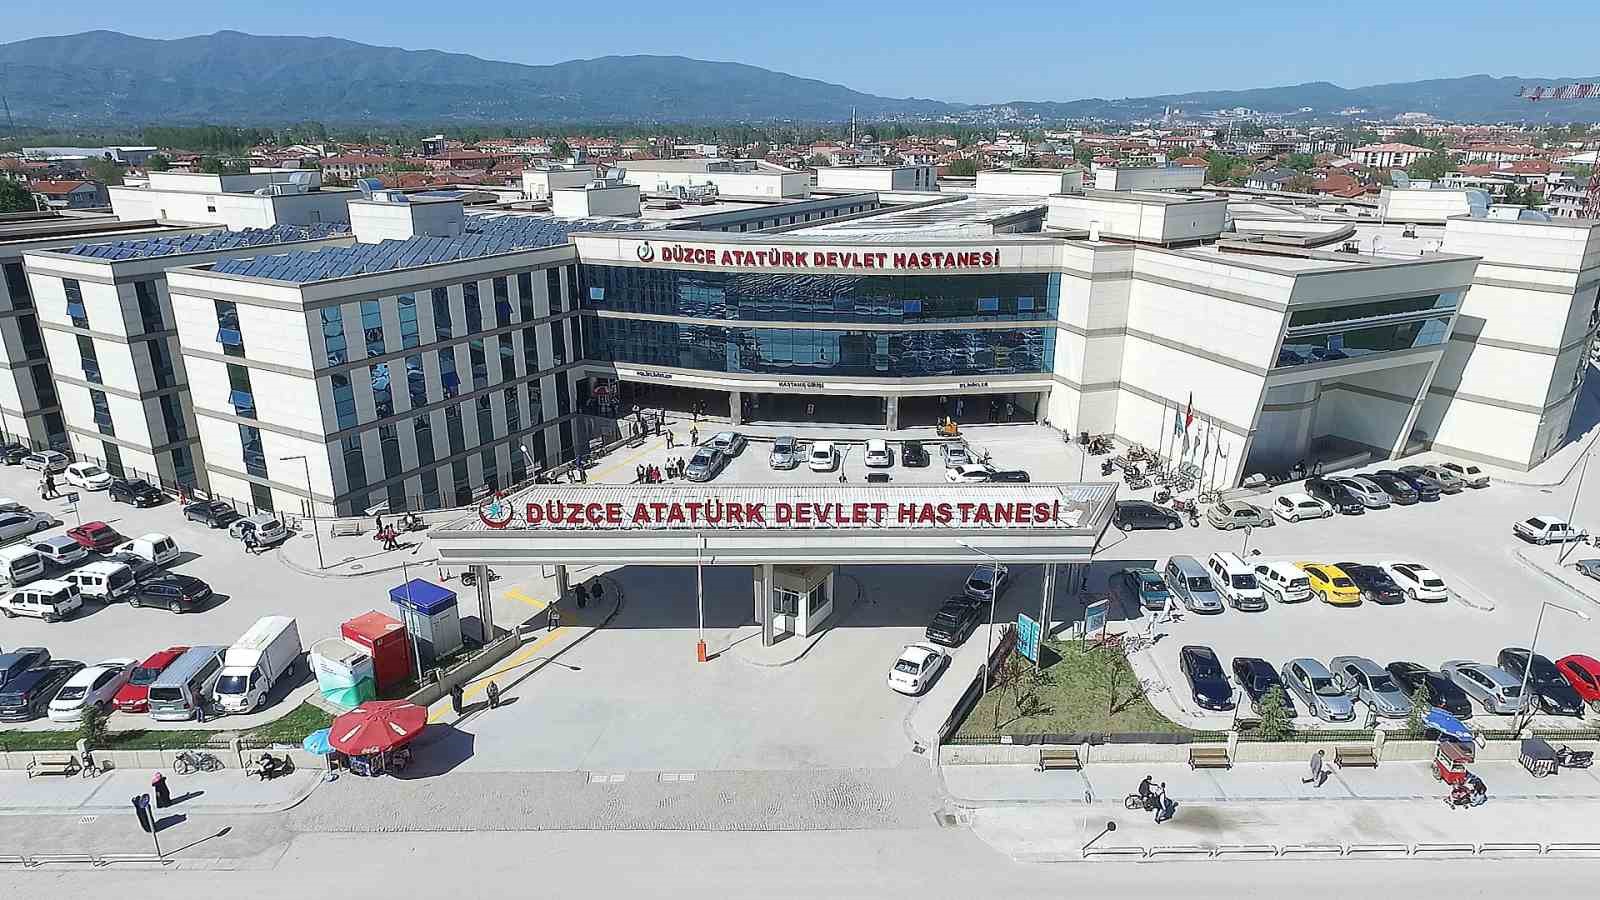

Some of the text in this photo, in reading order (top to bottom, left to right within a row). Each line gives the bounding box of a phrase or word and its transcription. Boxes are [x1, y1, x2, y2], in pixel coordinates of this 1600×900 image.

[662, 245, 1001, 269] DÜZCE ATATÜRK DEVLET HASTANESİ
[526, 499, 1059, 524] DÜZCE ATATÜRK DEVLET HASTANESİ
